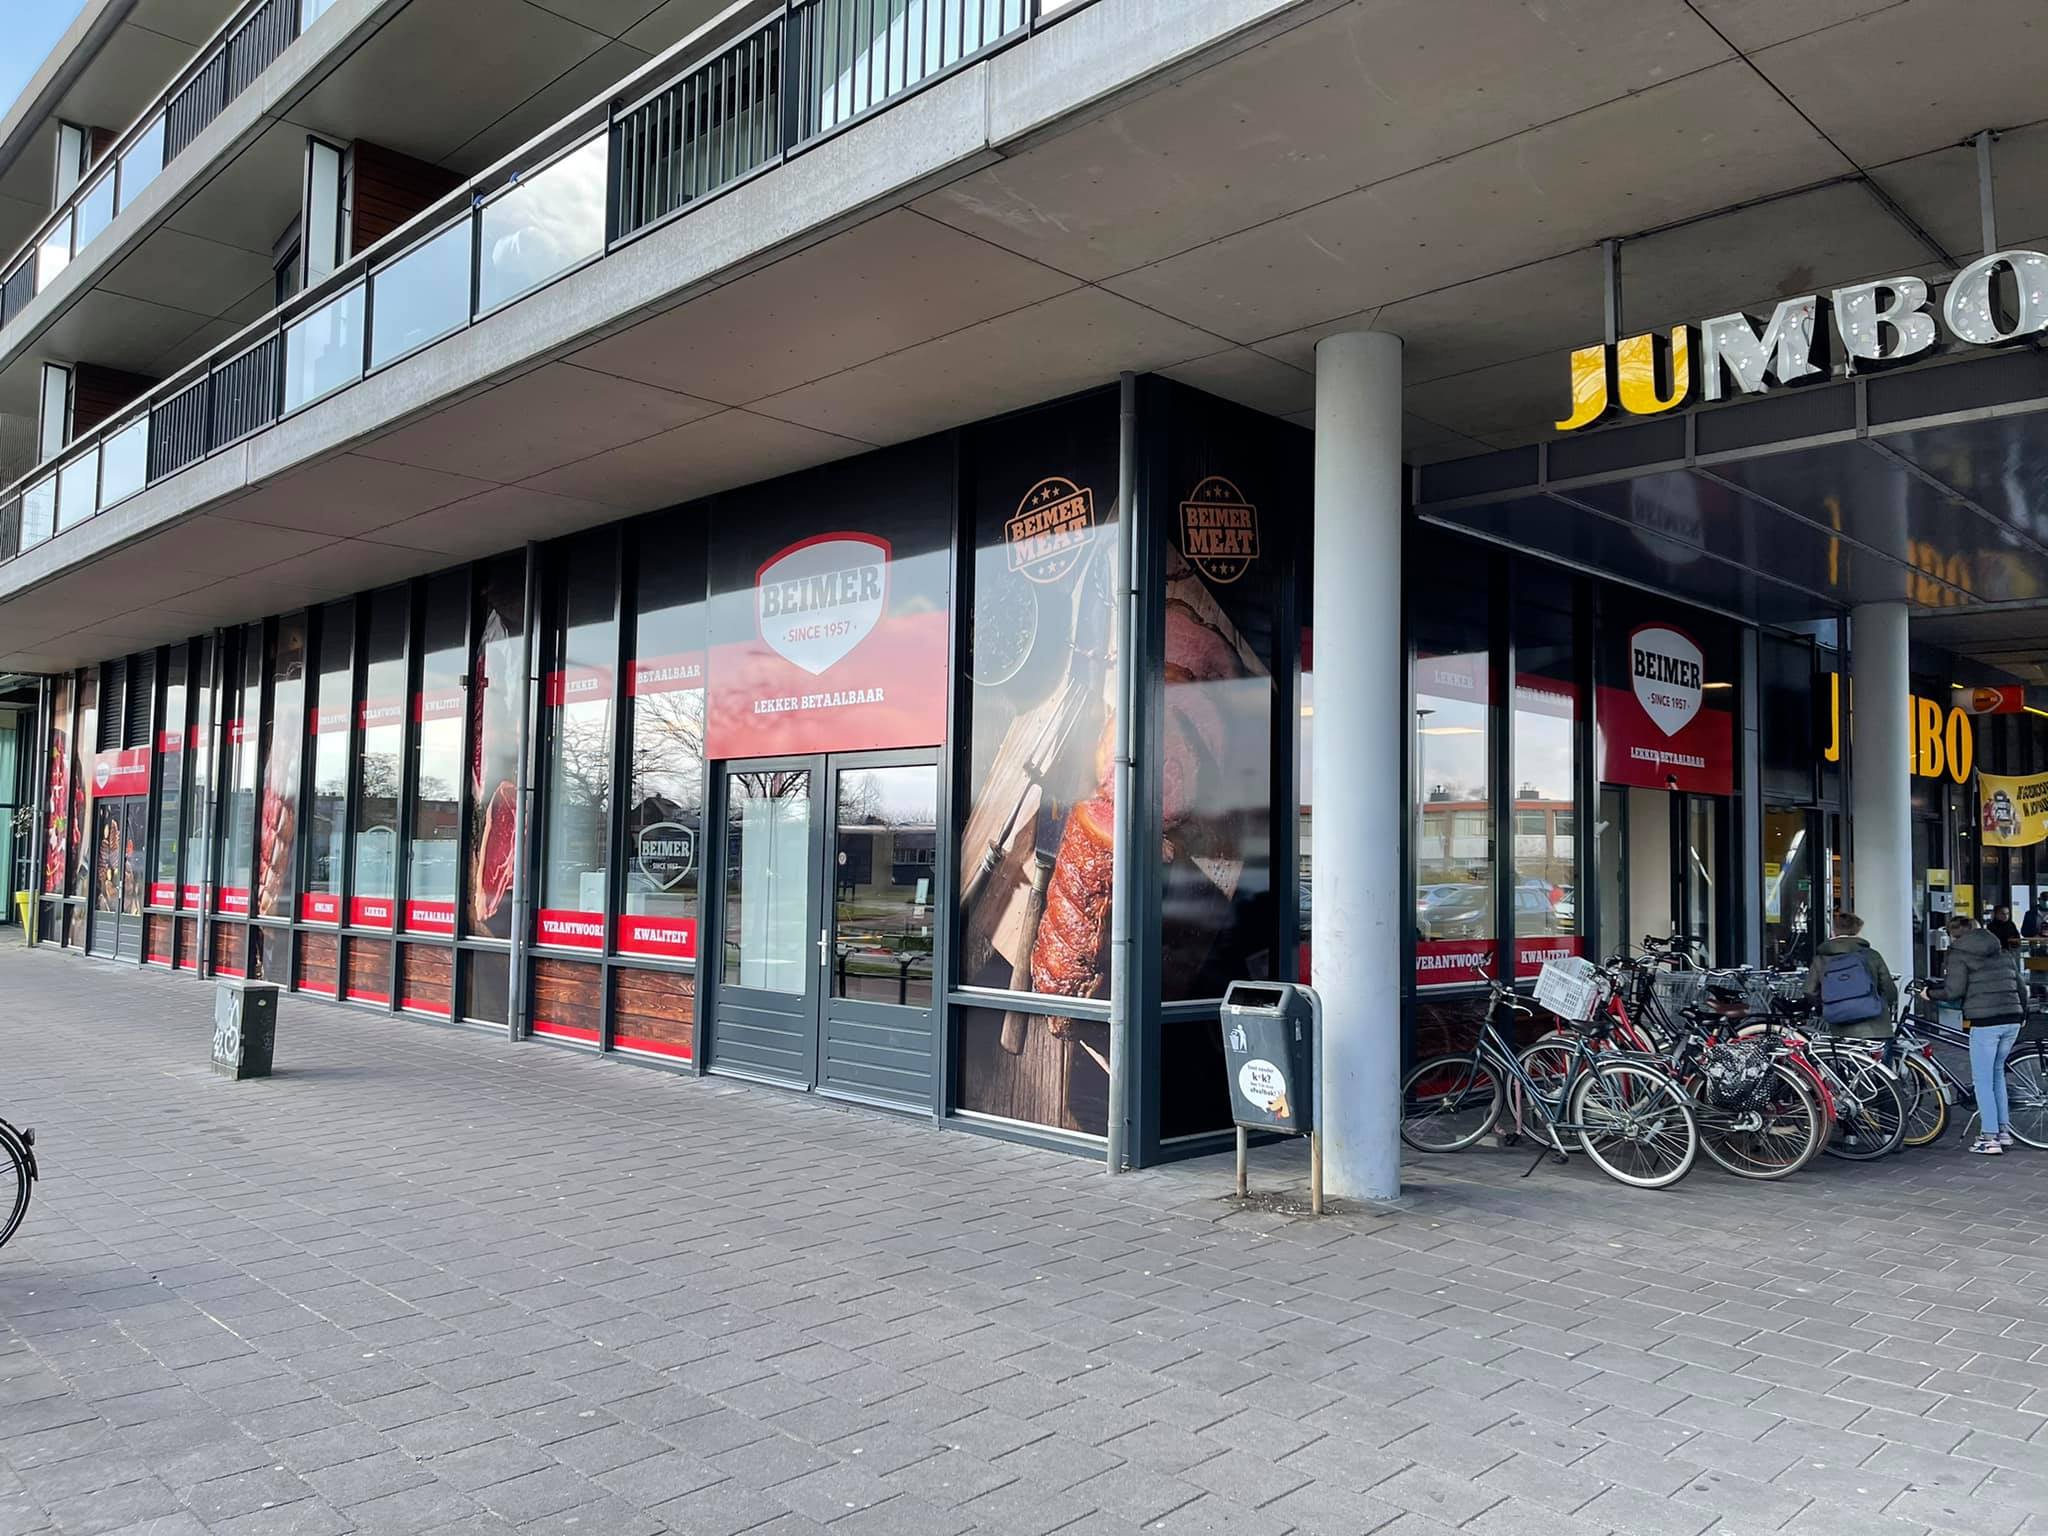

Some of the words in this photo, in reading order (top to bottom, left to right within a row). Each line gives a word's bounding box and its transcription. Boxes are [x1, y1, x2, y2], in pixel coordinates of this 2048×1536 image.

[1554, 249, 2048, 430] JUMBO
[1011, 496, 1087, 541] BEIMER
[1186, 507, 1251, 528] BEIMER
[1015, 515, 1088, 565] MEAT
[1189, 529, 1254, 554] MEAT
[762, 566, 881, 618] BEIMER
[788, 625, 821, 642] SINCE
[823, 621, 850, 637] 1957
[638, 665, 701, 684] BETAALBAAR
[1634, 648, 1701, 690] BEIMER
[754, 697, 799, 713] LEKKER
[801, 687, 885, 709] BETAALBAAR
[1651, 692, 1671, 708] SINCE
[1824, 671, 1973, 784] JBO
[641, 840, 690, 857] BEIMER
[633, 928, 688, 944] KWALITEIT
